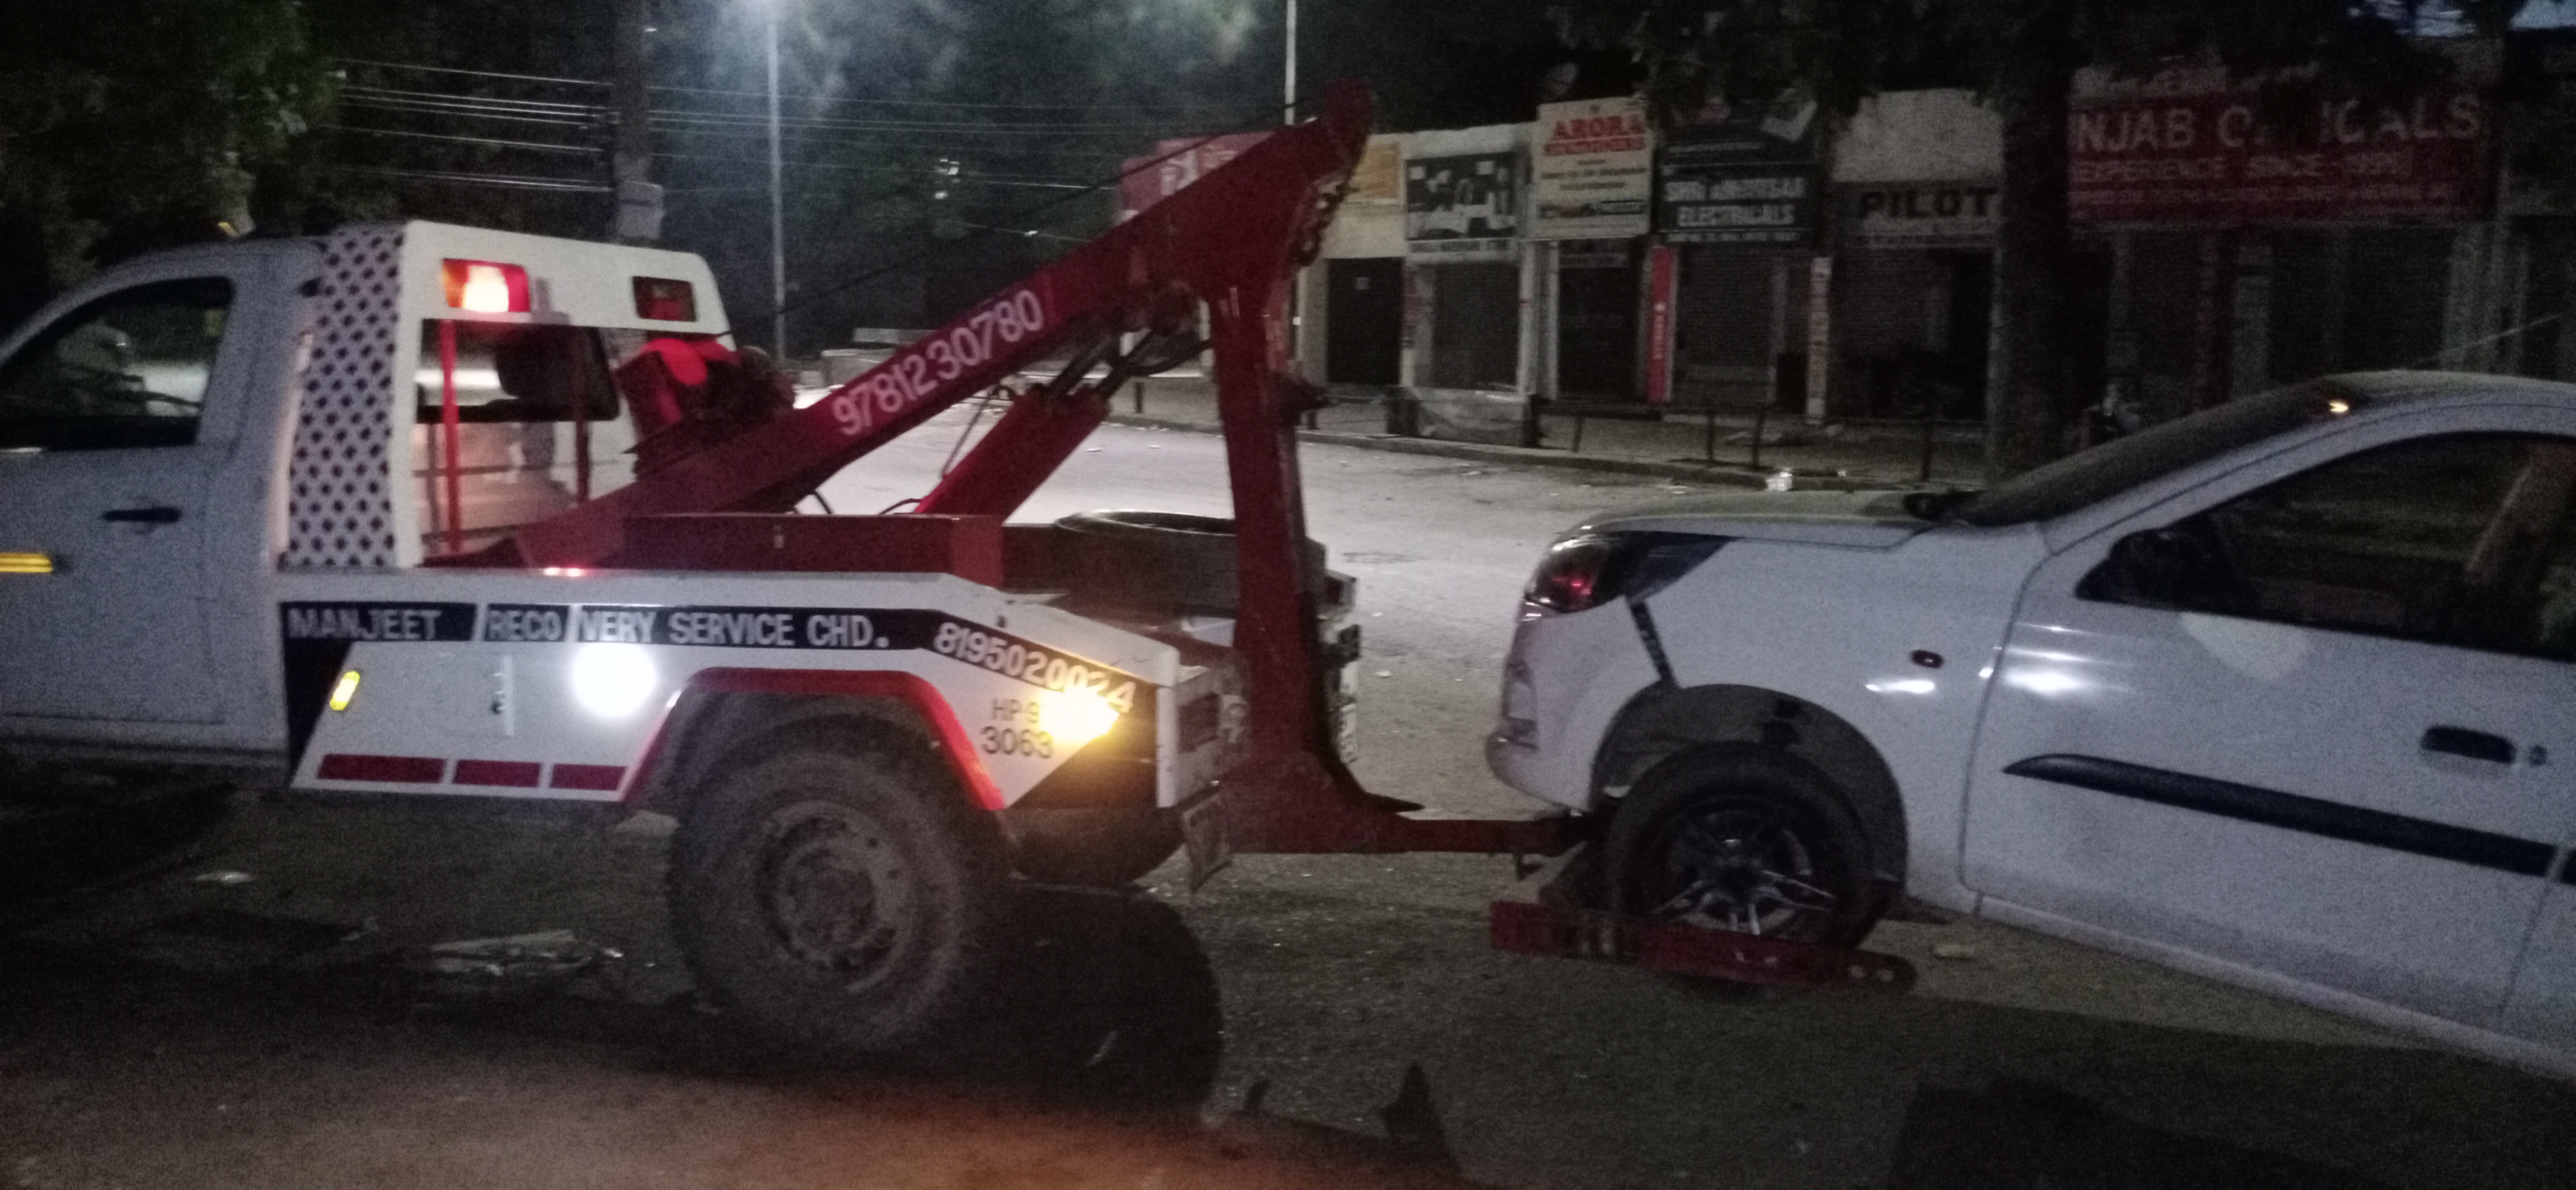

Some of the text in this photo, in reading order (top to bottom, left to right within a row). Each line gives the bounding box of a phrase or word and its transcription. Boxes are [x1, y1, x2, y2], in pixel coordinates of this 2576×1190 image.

[1551, 115, 1646, 140] ARORA
[1857, 186, 1998, 218] PILOT
[832, 289, 1044, 436] 9781230780
[287, 607, 443, 640] MANJEET
[666, 612, 796, 647] SERVICE
[806, 614, 891, 648] CHD.
[981, 725, 1054, 759] 3063
